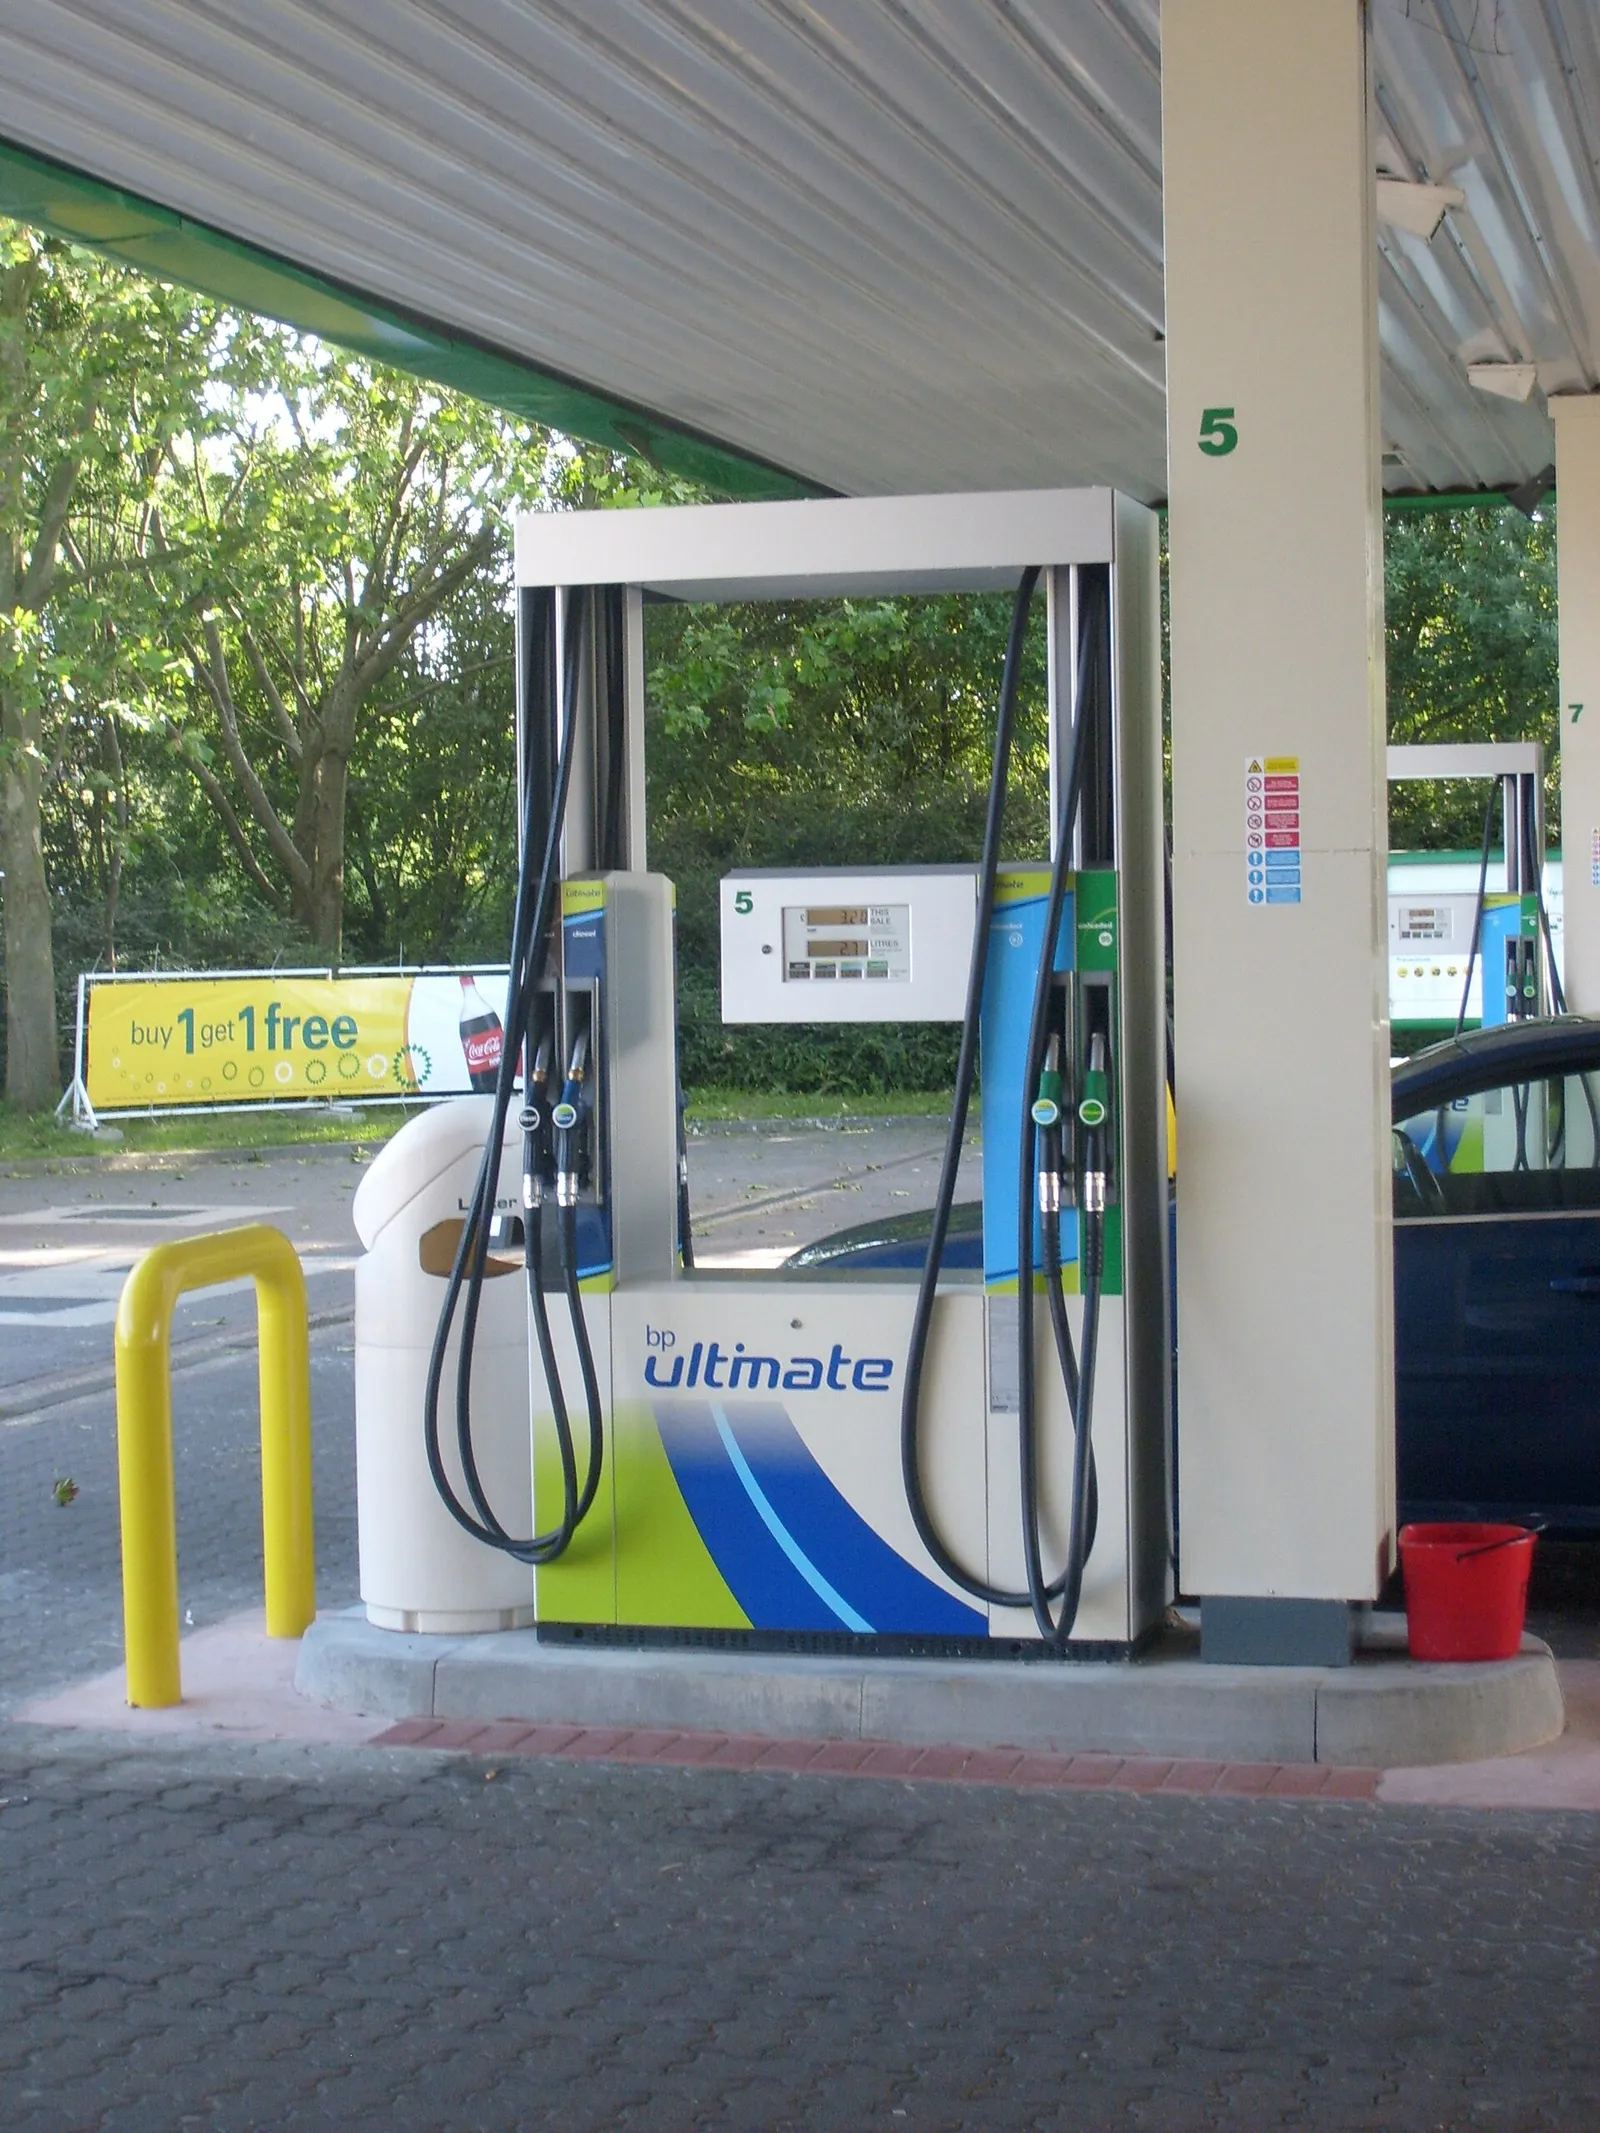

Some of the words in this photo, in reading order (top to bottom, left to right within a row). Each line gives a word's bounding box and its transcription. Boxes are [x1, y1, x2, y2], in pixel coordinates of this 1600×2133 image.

[1197, 407, 1238, 457] 5
[1567, 704, 1584, 724] 7
[734, 891, 754, 914] 5
[131, 1020, 173, 1050] buy
[177, 1007, 195, 1055] 1
[200, 1019, 236, 1049] get
[238, 1005, 255, 1052] 1
[264, 1002, 359, 1051] free
[645, 1325, 677, 1352] bp
[644, 1342, 894, 1392] ultimate
